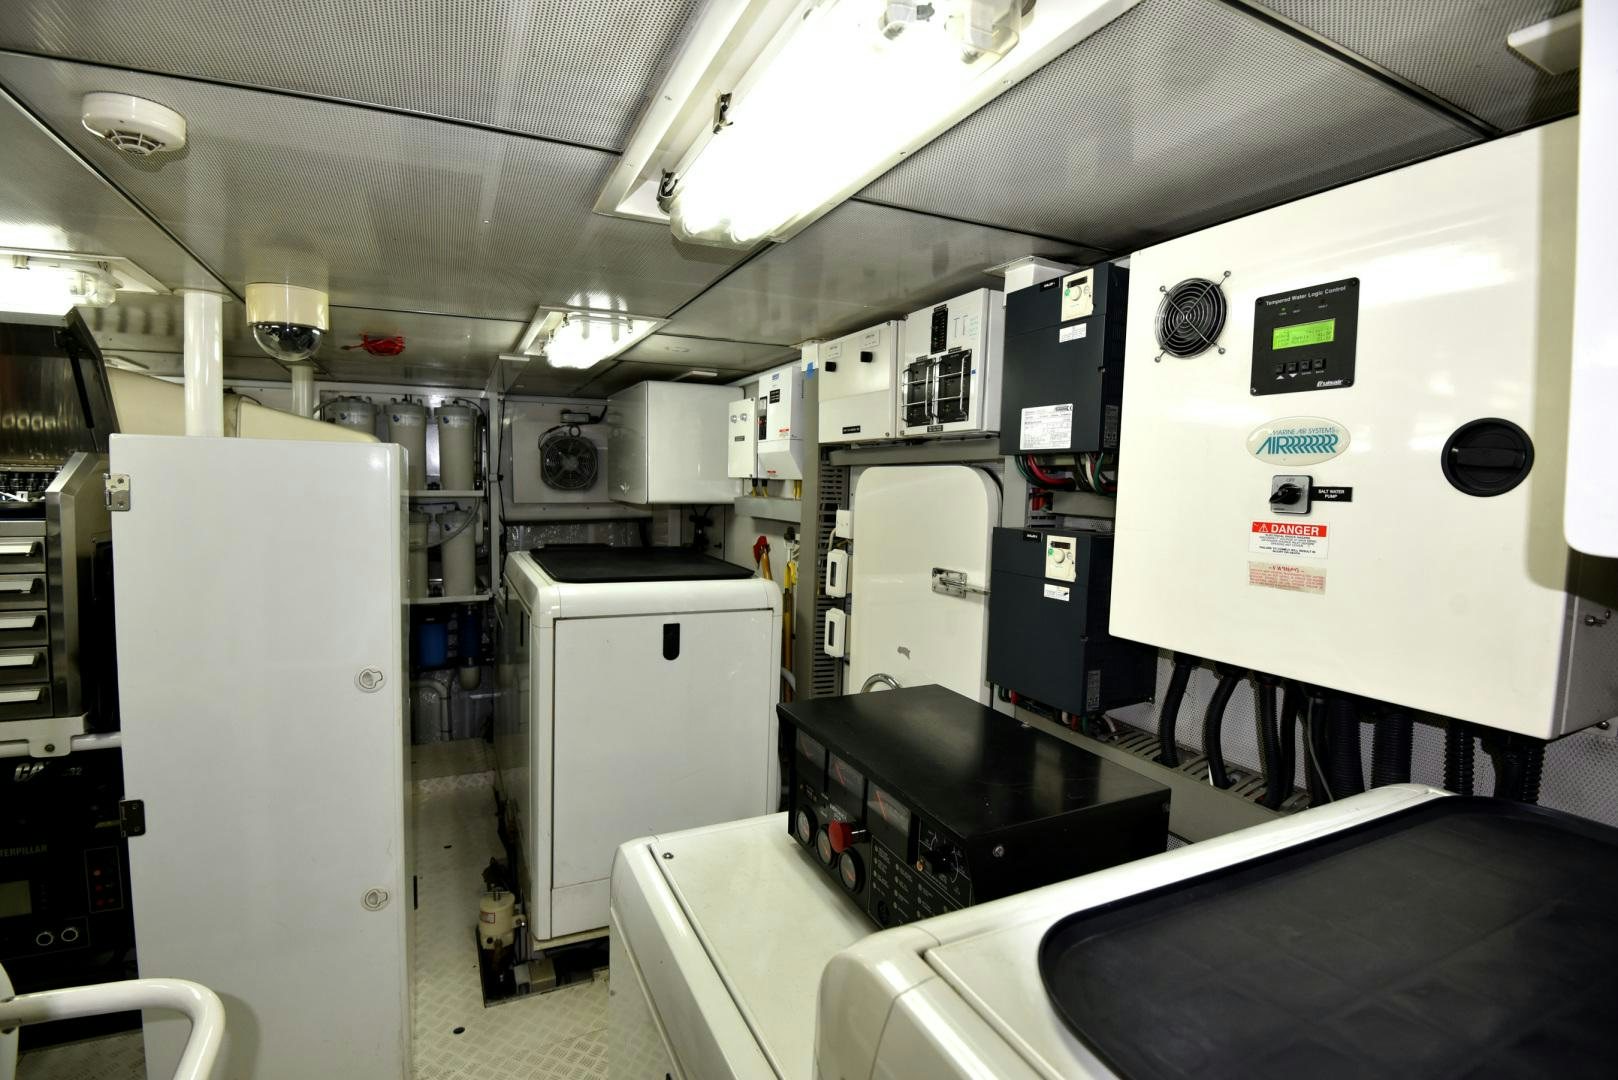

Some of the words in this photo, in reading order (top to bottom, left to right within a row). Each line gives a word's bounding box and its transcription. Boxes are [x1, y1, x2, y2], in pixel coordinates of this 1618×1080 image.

[1266, 297, 1291, 306] Tempered
[1291, 293, 1307, 301] Water
[1308, 290, 1323, 299] Logic
[1324, 286, 1346, 295] Control
[1270, 524, 1320, 536] DANGER
